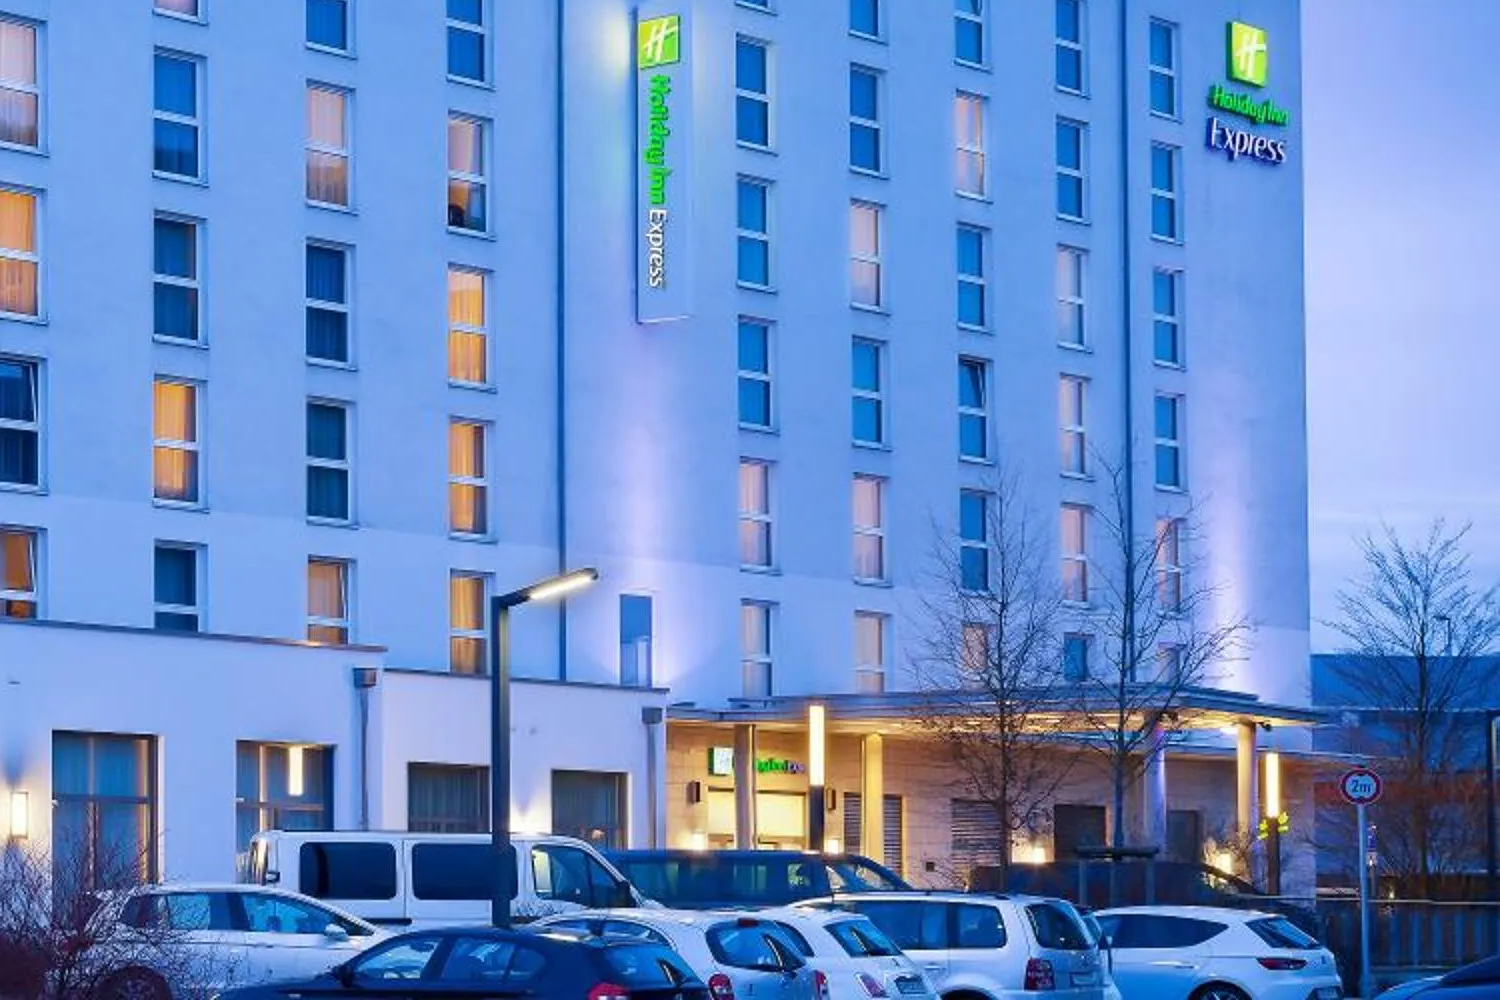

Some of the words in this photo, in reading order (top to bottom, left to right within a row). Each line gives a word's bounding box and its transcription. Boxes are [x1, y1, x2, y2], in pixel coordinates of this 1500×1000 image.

[643, 74, 670, 165] Holiday
[1212, 83, 1267, 123] Holiday
[1266, 99, 1289, 124] Inn
[1209, 116, 1287, 163] Express
[645, 208, 668, 289] Express
[1351, 778, 1371, 793] 2m
